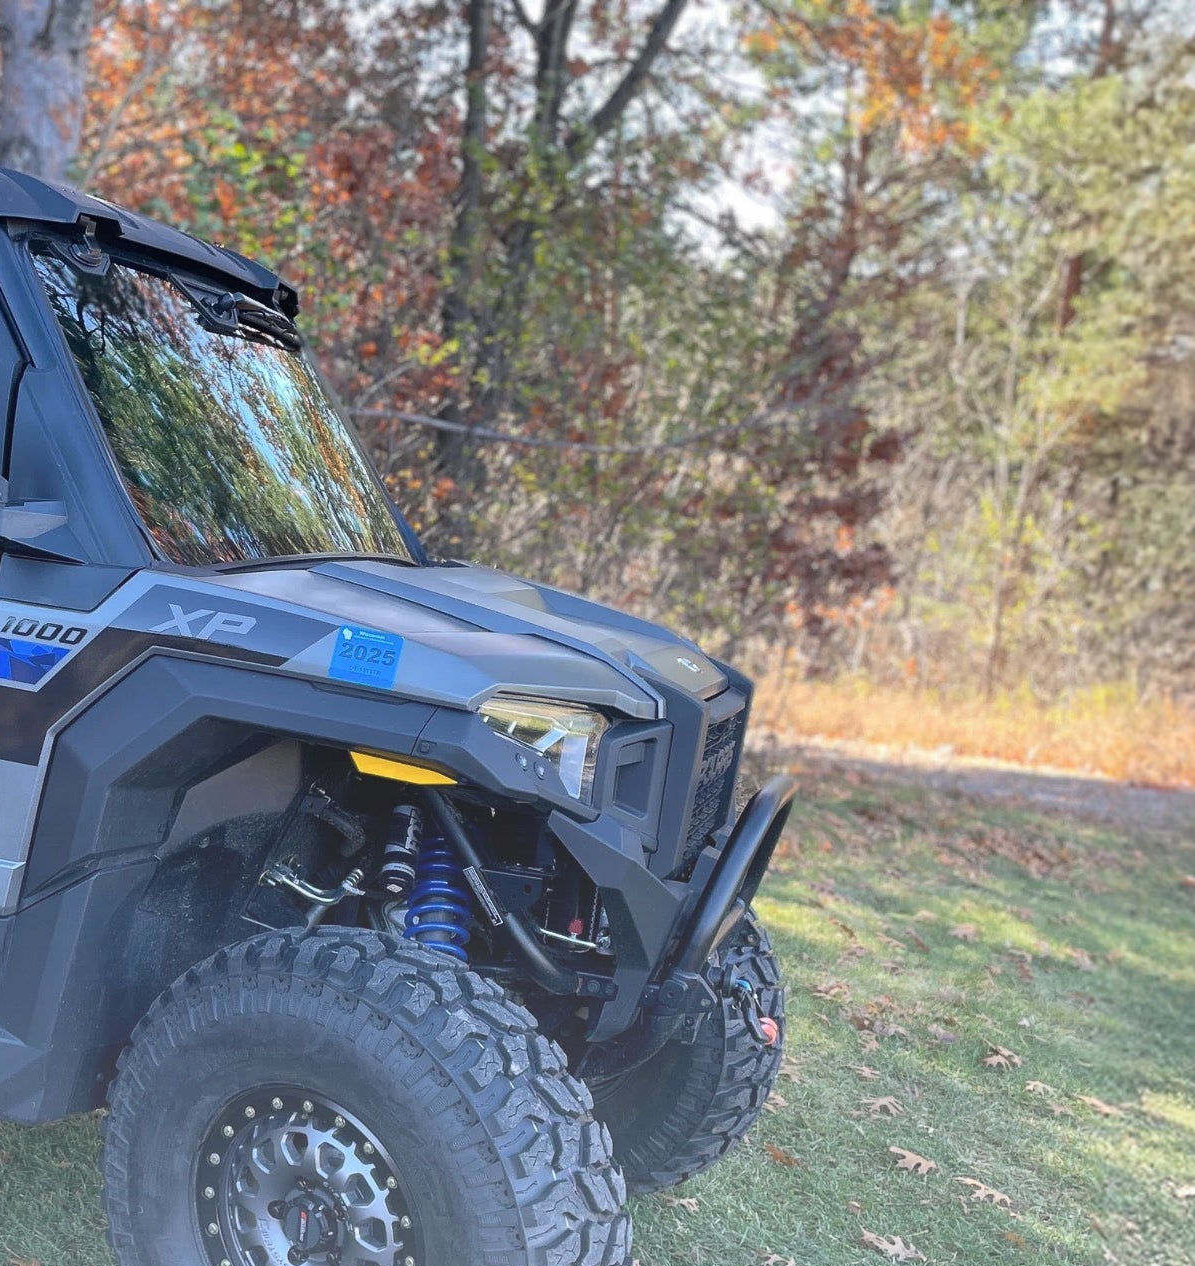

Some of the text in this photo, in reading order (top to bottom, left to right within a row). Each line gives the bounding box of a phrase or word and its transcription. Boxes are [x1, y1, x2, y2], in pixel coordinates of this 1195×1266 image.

[1, 616, 88, 645] 1000
[148, 603, 256, 641] XP
[338, 642, 396, 666] 2025
